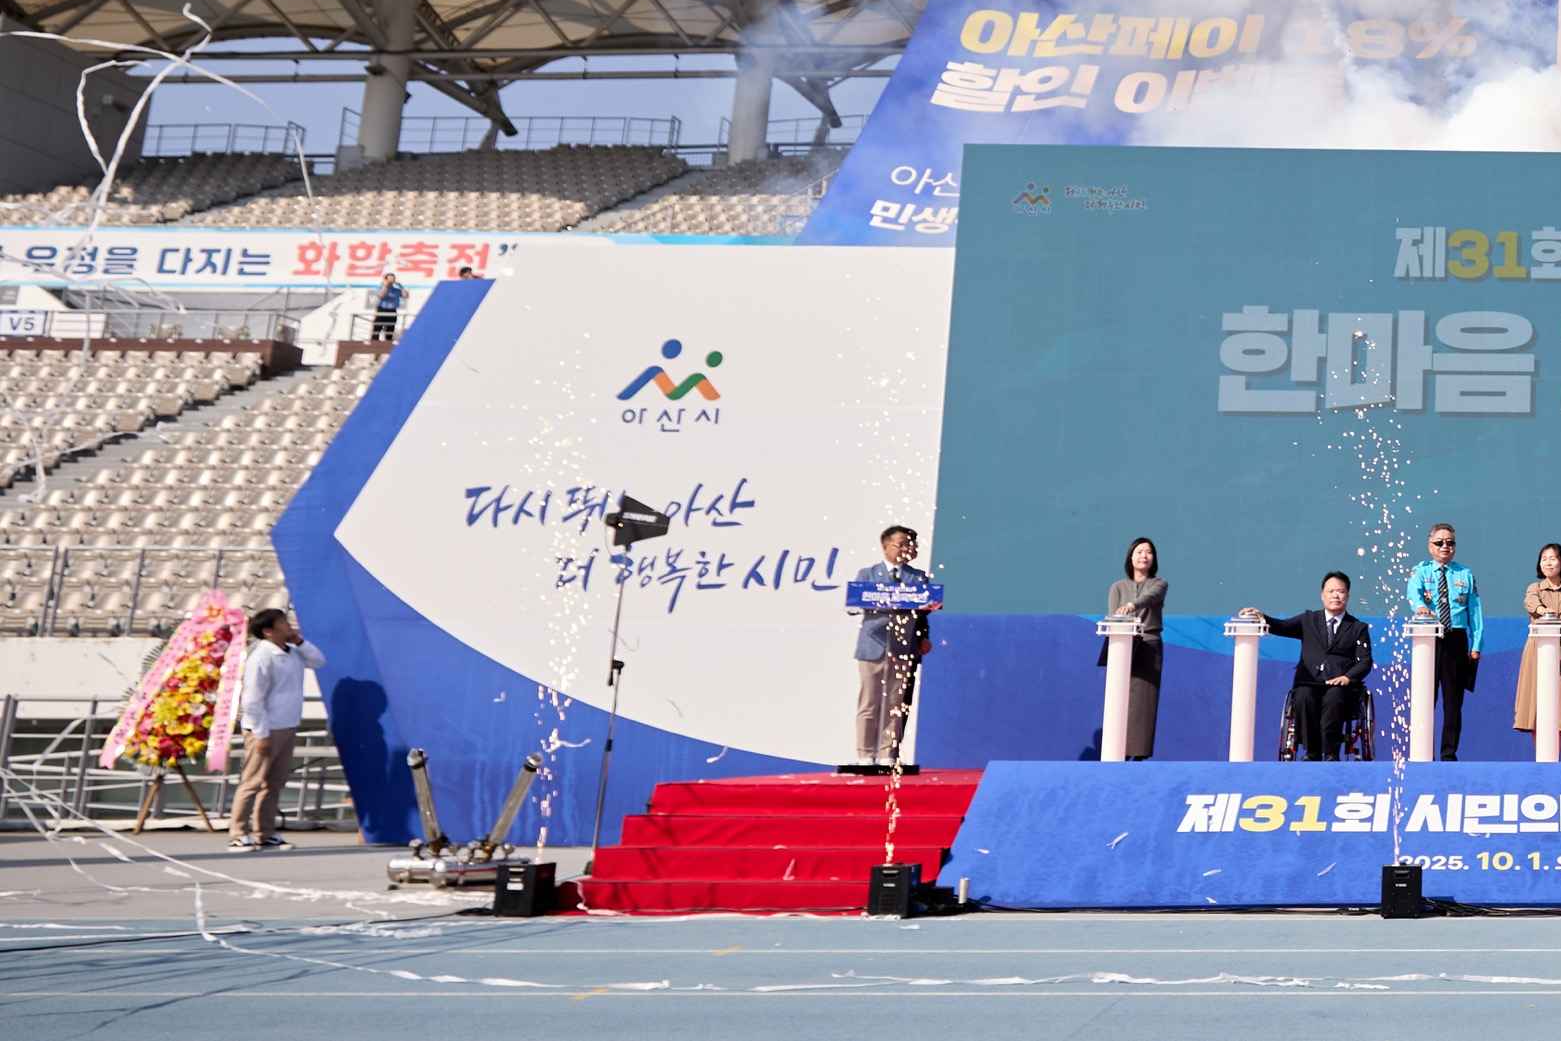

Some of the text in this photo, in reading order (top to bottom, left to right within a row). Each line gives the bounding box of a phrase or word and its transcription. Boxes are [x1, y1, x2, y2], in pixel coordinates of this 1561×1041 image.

[960, 10, 1264, 59] 아산페이
[930, 61, 1099, 112] 할인
[157, 246, 271, 276] 다지는
[9, 316, 35, 331] V5
[1217, 304, 1536, 415] 한마음
[621, 407, 721, 433] 아산시
[464, 485, 553, 529] 다시
[664, 477, 756, 527] 아산
[555, 547, 840, 613] 더 행복한 시민
[1176, 793, 1391, 833] 제31회
[1476, 851, 1521, 871] 10.
[1527, 852, 1549, 871] 1.
